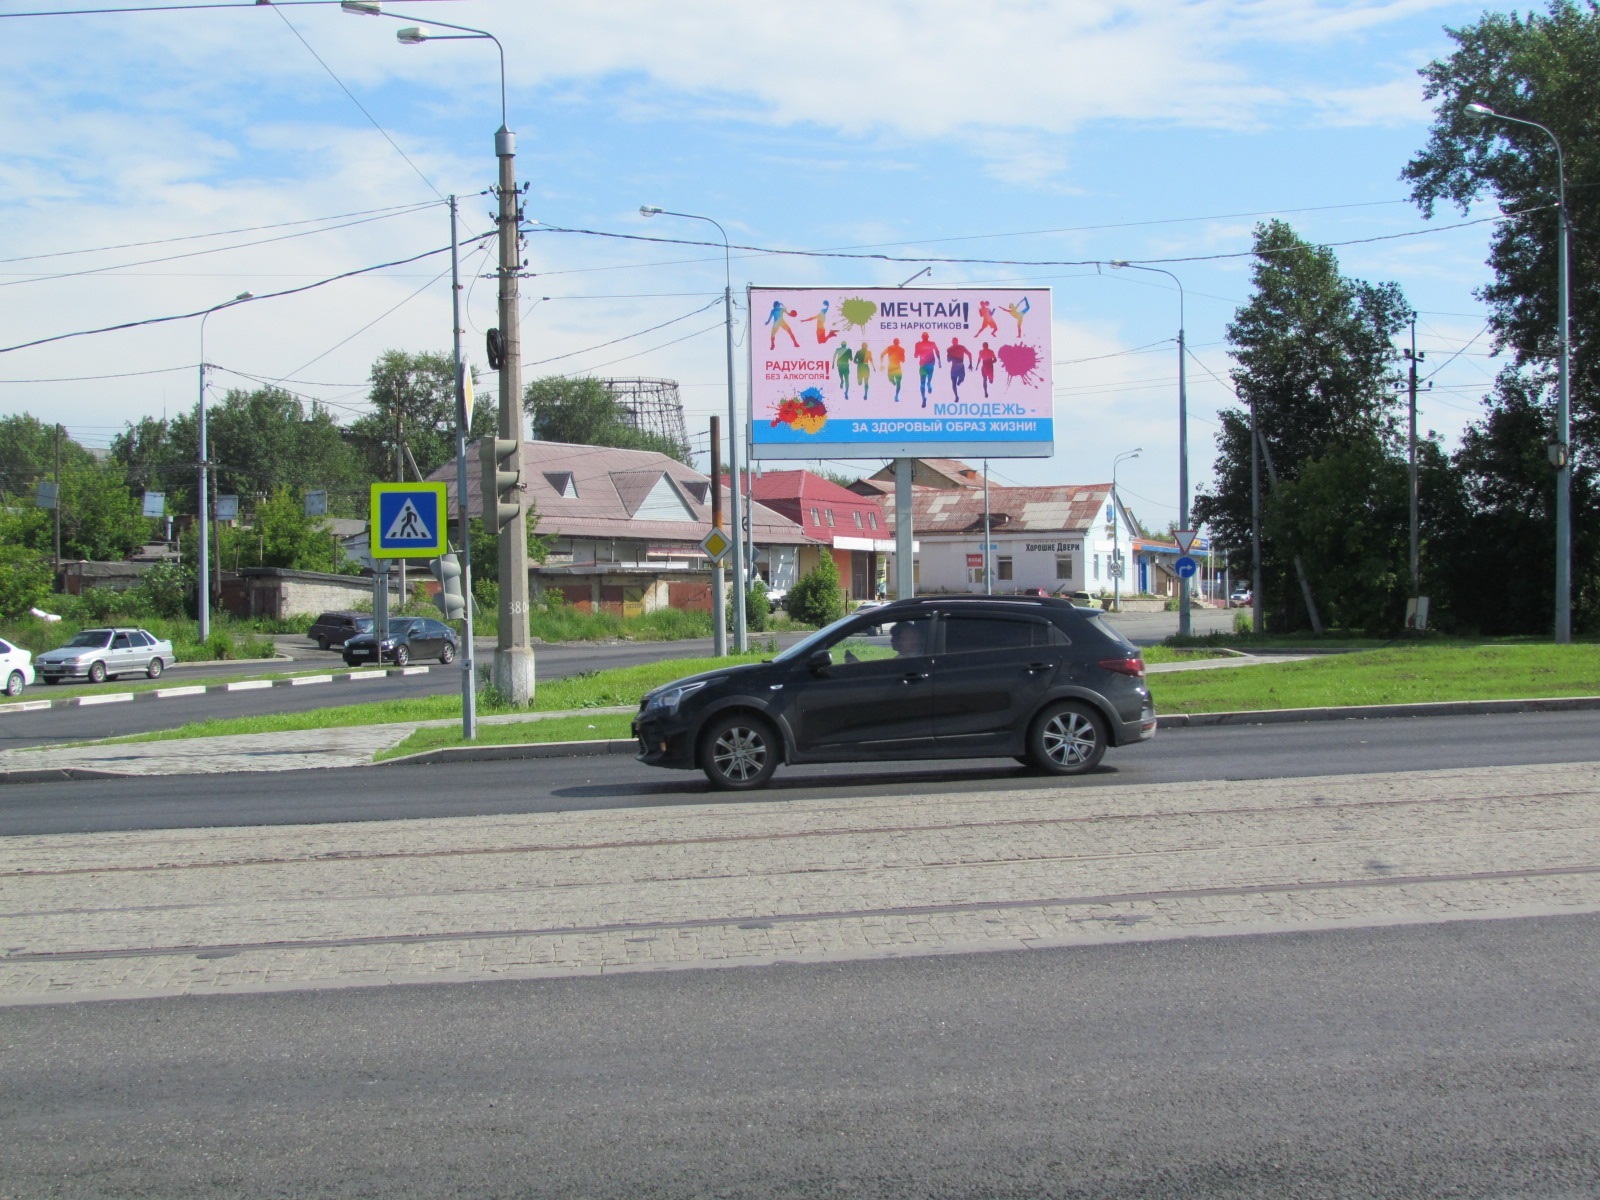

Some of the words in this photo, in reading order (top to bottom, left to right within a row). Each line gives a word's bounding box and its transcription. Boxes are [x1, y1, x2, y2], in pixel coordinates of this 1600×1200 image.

[880, 299, 969, 329] МЕЧТАЙ!
[880, 322, 898, 330] БЕЗ
[900, 322, 962, 330] НАРКОТИКОВ
[765, 358, 830, 380] РАДУЙСЯ!
[934, 403, 1026, 417] МОЛОДЕЖЬ
[852, 422, 868, 433] ЗА
[871, 420, 943, 434] ЗДОРОВЫЙ
[945, 421, 986, 432] ОБРАЗ
[989, 421, 1037, 432] ЖИЗНИ!
